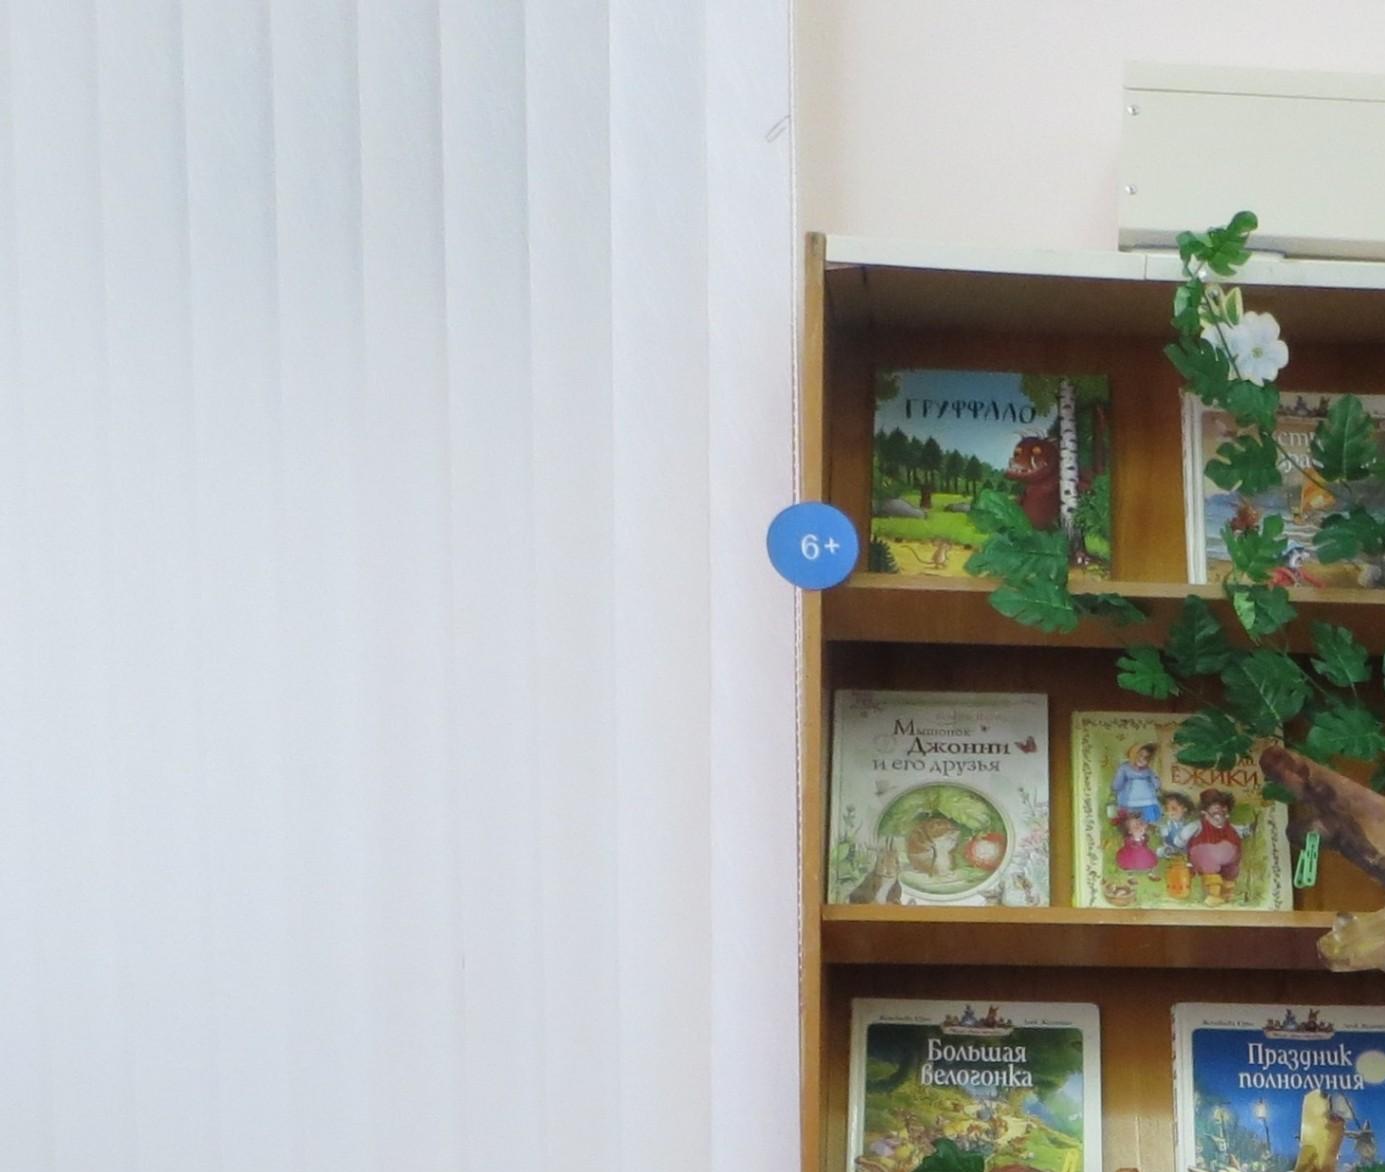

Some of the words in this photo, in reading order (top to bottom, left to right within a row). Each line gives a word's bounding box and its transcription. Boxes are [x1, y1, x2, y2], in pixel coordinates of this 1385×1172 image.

[906, 399, 1036, 424] ГРУФФАЛО
[801, 534, 840, 560] 6+
[907, 736, 1011, 756] Джонни
[872, 759, 886, 771] и
[892, 759, 925, 771] его
[929, 759, 1000, 777] друзья
[1171, 766, 1258, 787] ЕЖИКИ
[927, 1038, 1027, 1063] Большая
[1248, 1043, 1352, 1070] Праздник
[921, 1063, 1033, 1087] велогонка
[1239, 1071, 1365, 1090] полнолуния
